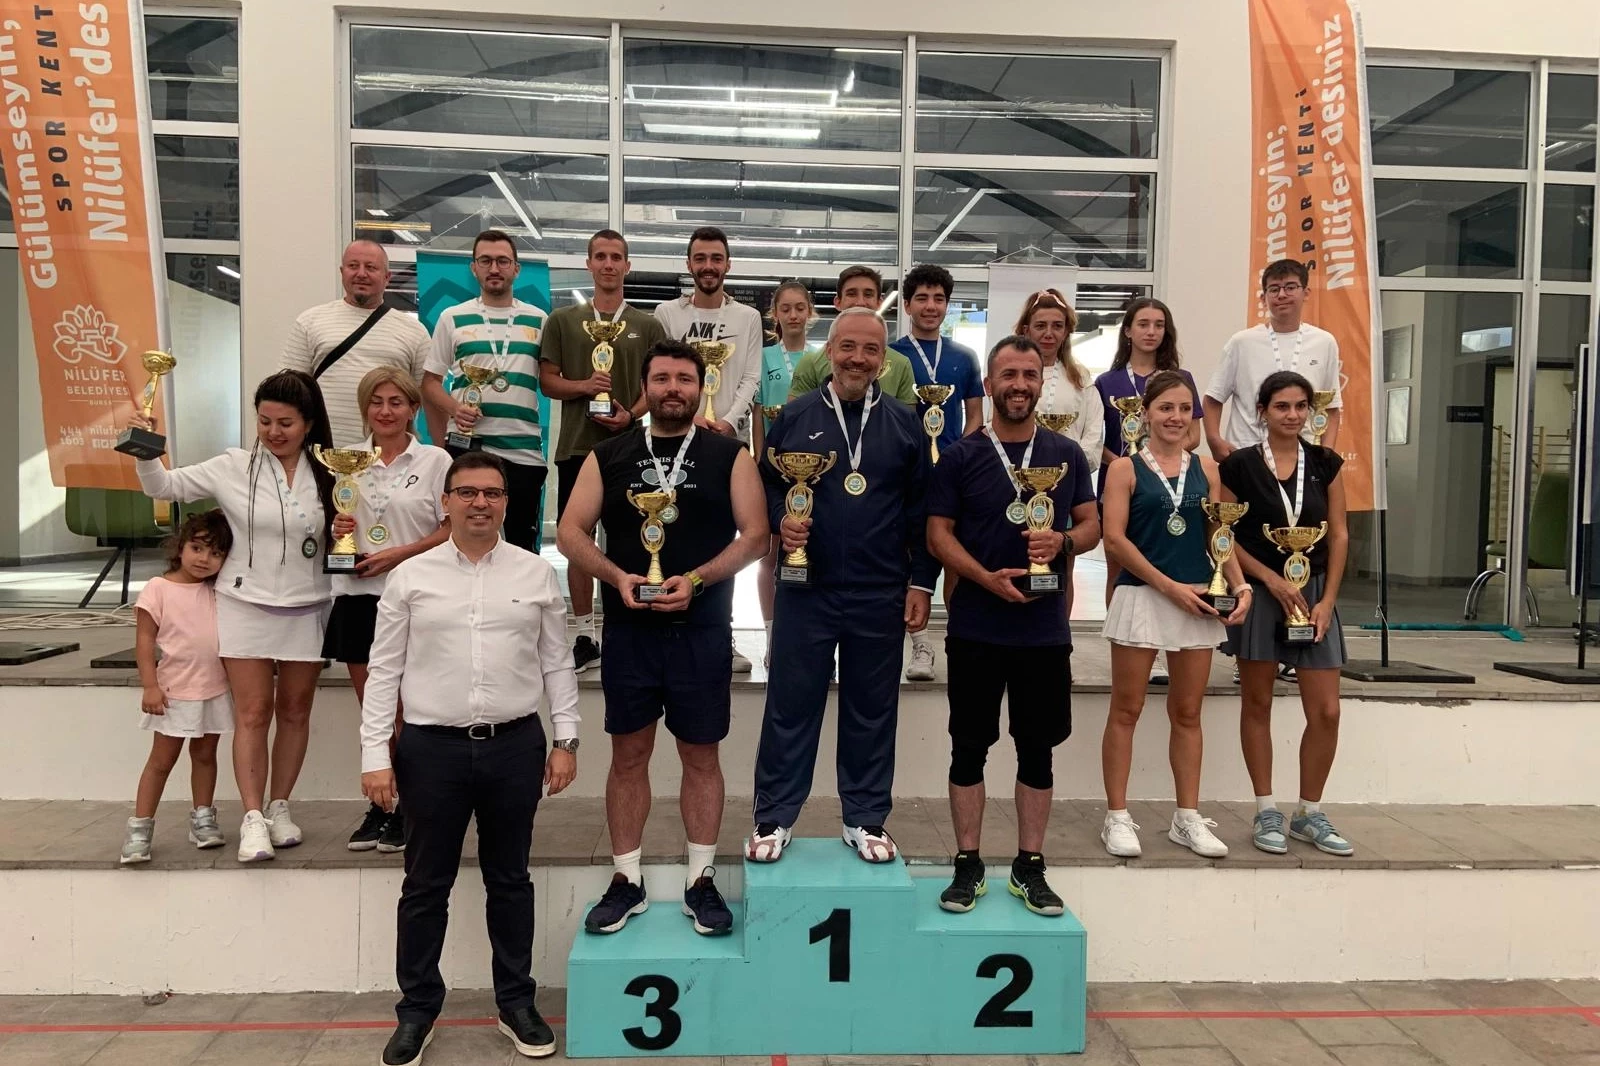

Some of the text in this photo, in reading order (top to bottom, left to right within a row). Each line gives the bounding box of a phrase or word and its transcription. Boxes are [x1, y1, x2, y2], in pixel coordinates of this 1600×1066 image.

[33, 4, 73, 212] SPOR KENT
[1312, 13, 1354, 291] Nilüfer'desiniz
[687, 321, 726, 339] NIKE
[63, 366, 128, 382] NİLÜFER
[808, 908, 851, 983] 1
[621, 973, 682, 1051] 3
[973, 952, 1034, 1028] 2
